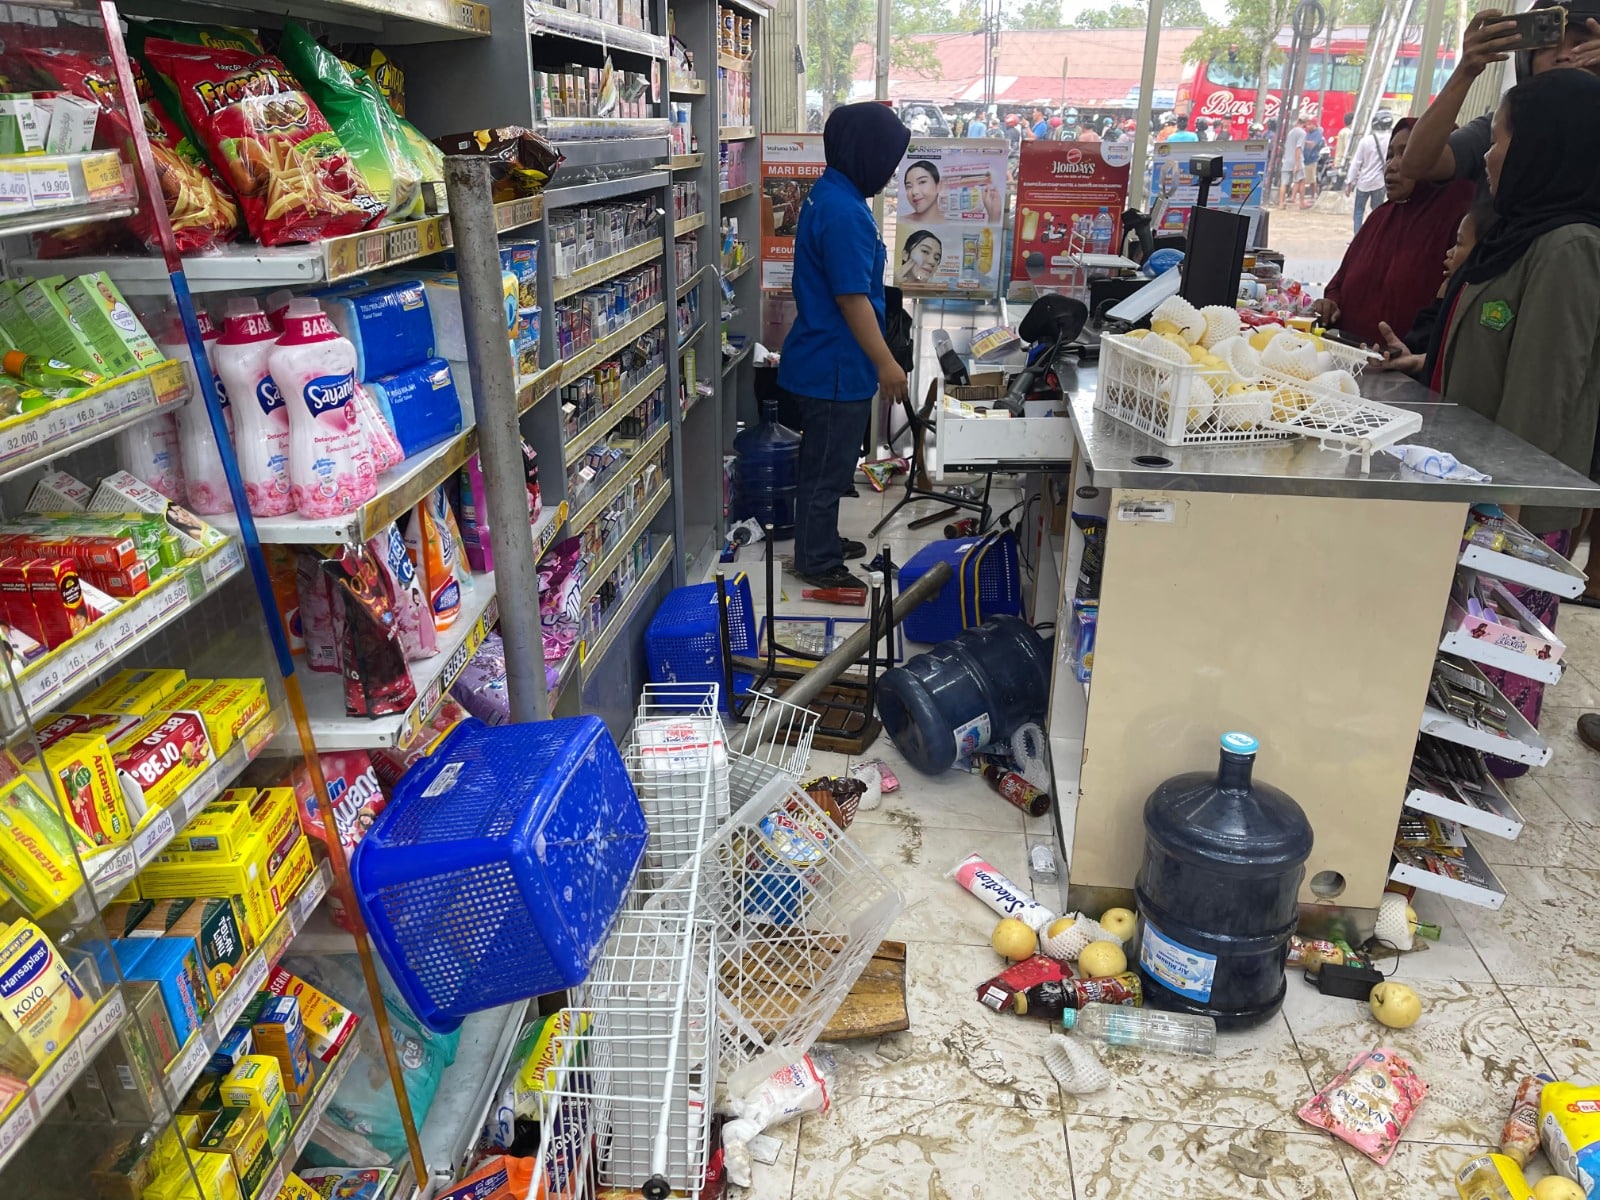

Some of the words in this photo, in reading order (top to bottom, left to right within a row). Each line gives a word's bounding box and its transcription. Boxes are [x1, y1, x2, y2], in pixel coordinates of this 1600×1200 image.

[42, 180, 69, 192] 19.900
[768, 166, 795, 175] MARI
[7, 430, 39, 450] 32.000
[164, 584, 187, 606] 18.500
[142, 717, 187, 746] BEJO
[137, 742, 180, 783] BEJO
[92, 754, 116, 815] Antangin
[146, 817, 171, 844] 22.000
[10, 825, 66, 883] Antangin
[975, 868, 1026, 914] Selection
[217, 915, 234, 957] TOLAK
[0, 946, 47, 993] Hansaplast
[1155, 953, 1178, 970] Minum
[1178, 966, 1189, 975] Air
[12, 985, 44, 1019] KOYO
[92, 1003, 121, 1036] 11.000
[50, 1050, 79, 1087] 11.000
[182, 1043, 205, 1076] 28.000
[531, 1031, 563, 1080] HANGOUT
[1336, 1089, 1387, 1124] NAEEM
